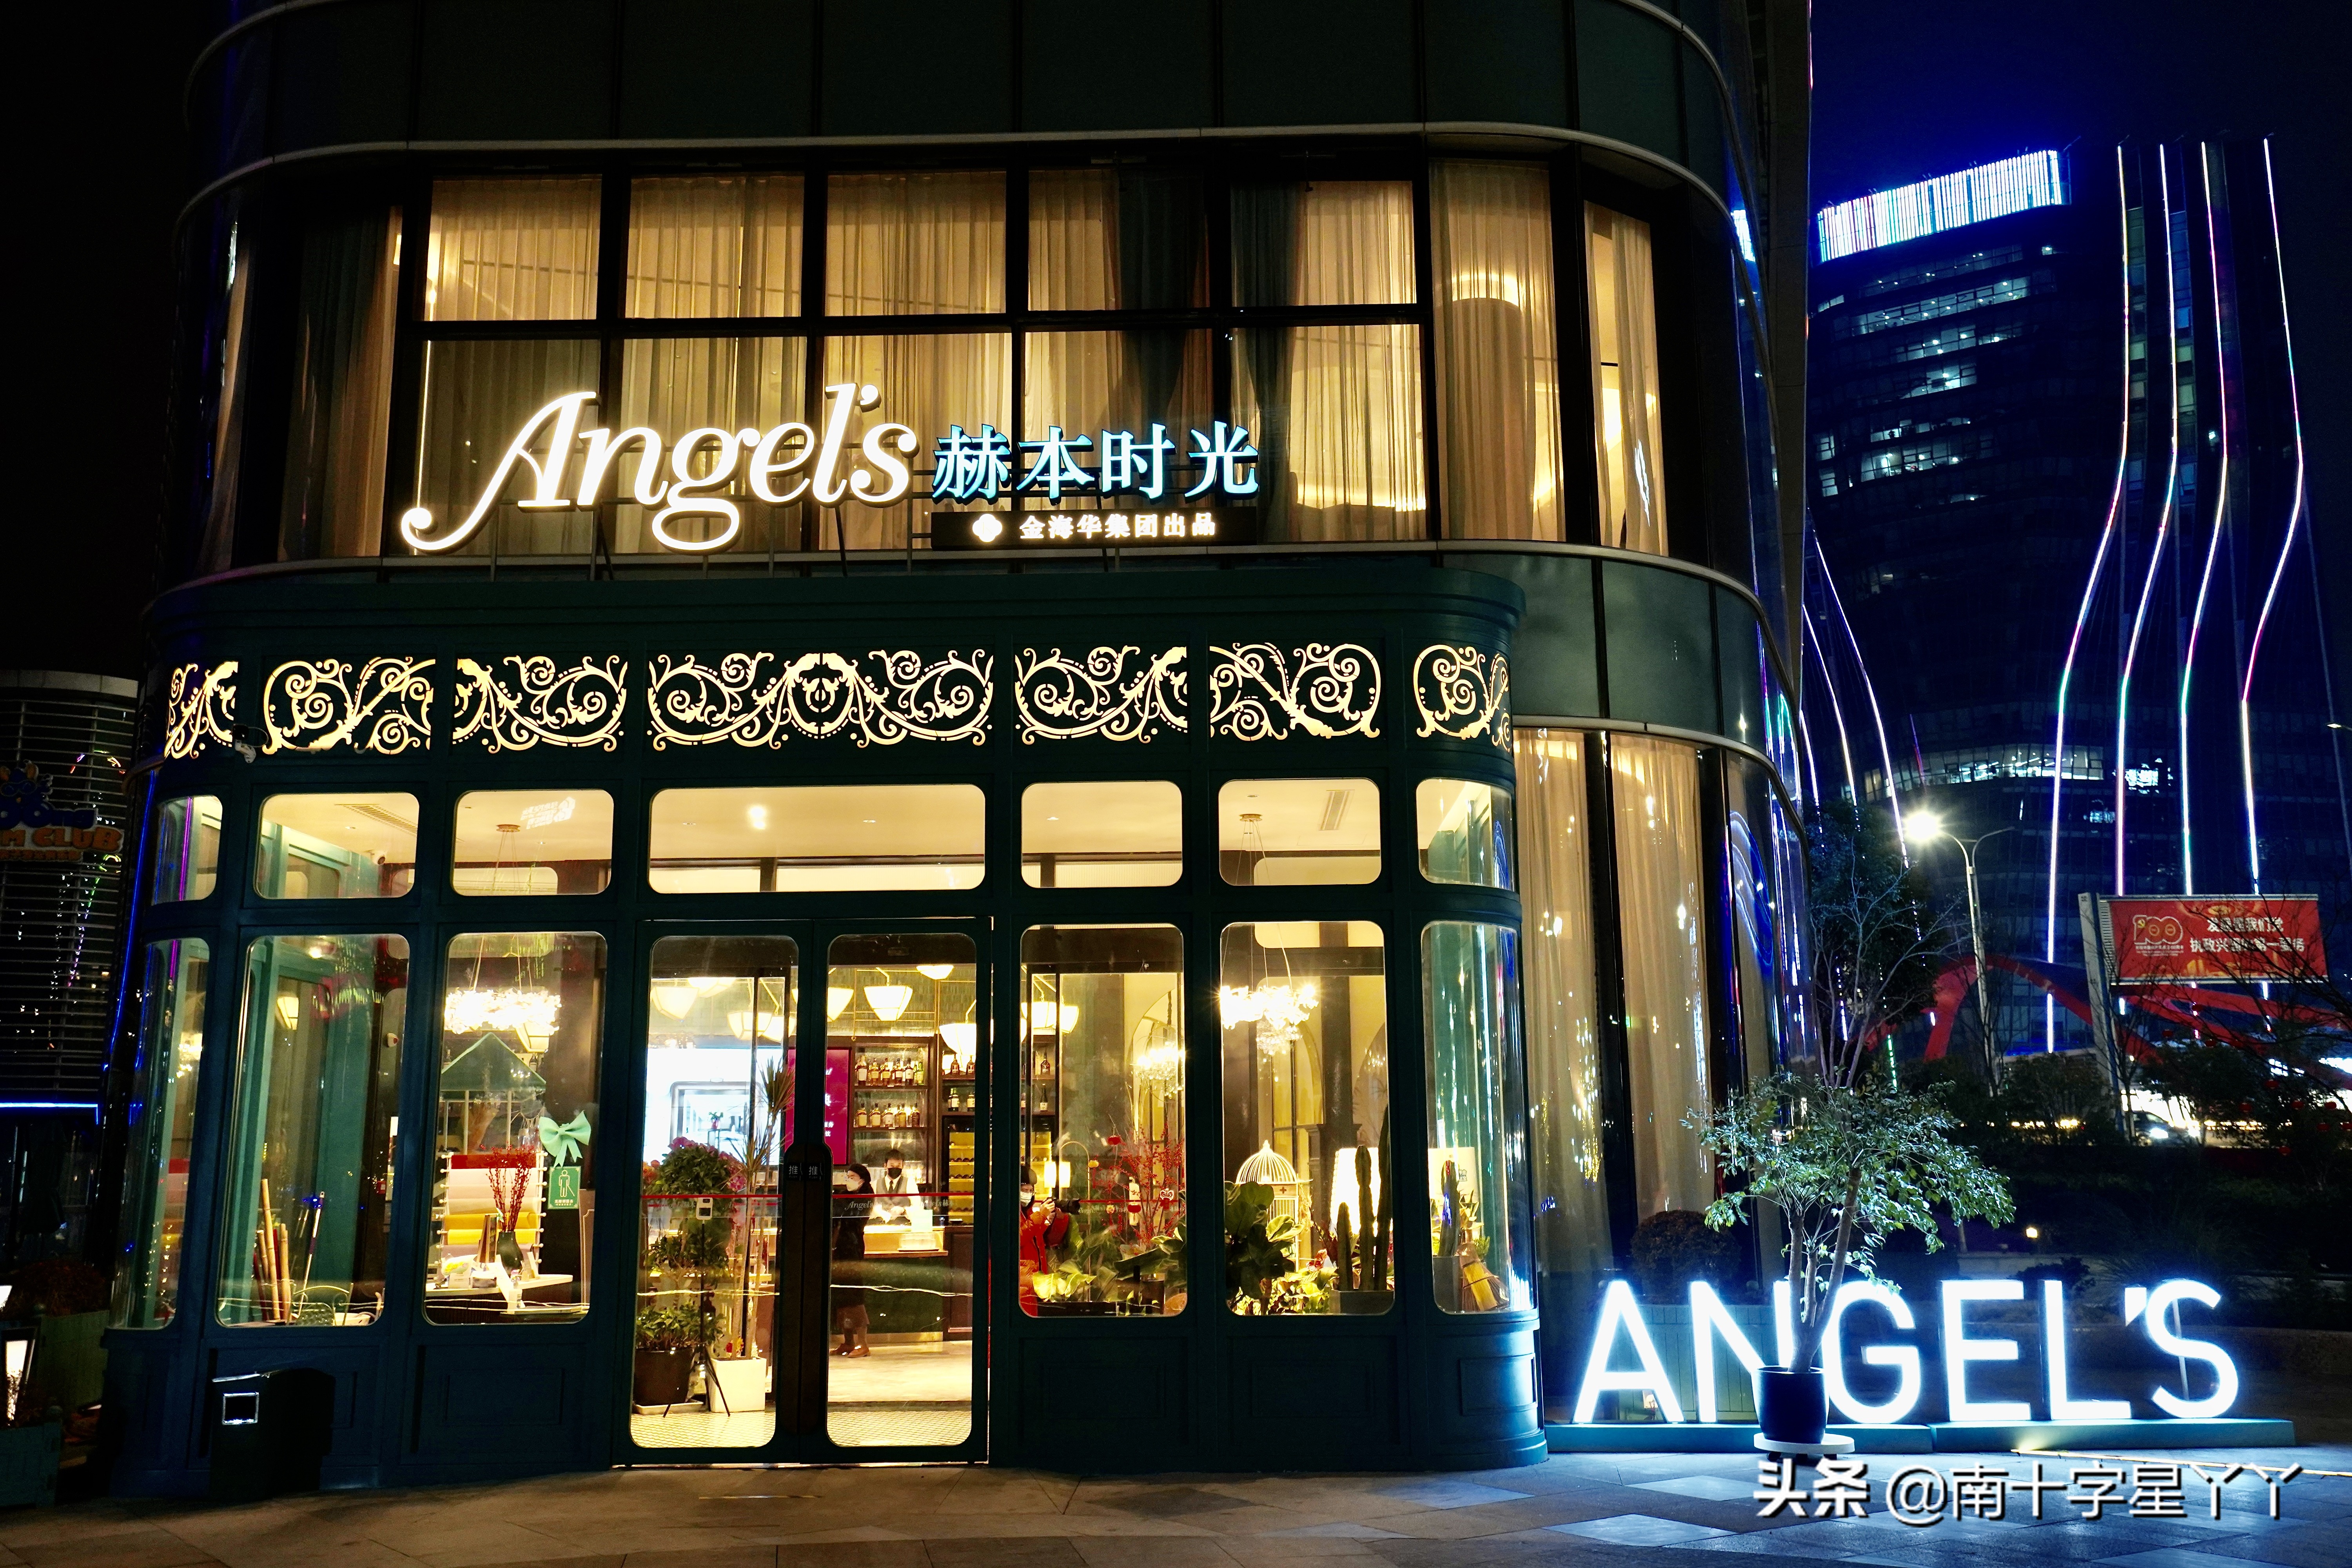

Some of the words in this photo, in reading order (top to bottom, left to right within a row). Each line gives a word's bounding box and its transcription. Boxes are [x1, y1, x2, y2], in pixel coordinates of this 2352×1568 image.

[401, 382, 918, 551] Angel's
[932, 421, 1259, 503] 赫本时光
[1019, 512, 1216, 539] 金海华集团出品
[33, 827, 122, 852] CLUB
[789, 1165, 798, 1175] 推
[809, 1165, 818, 1175] 推
[1572, 1278, 2239, 1425] ANGEL'S
